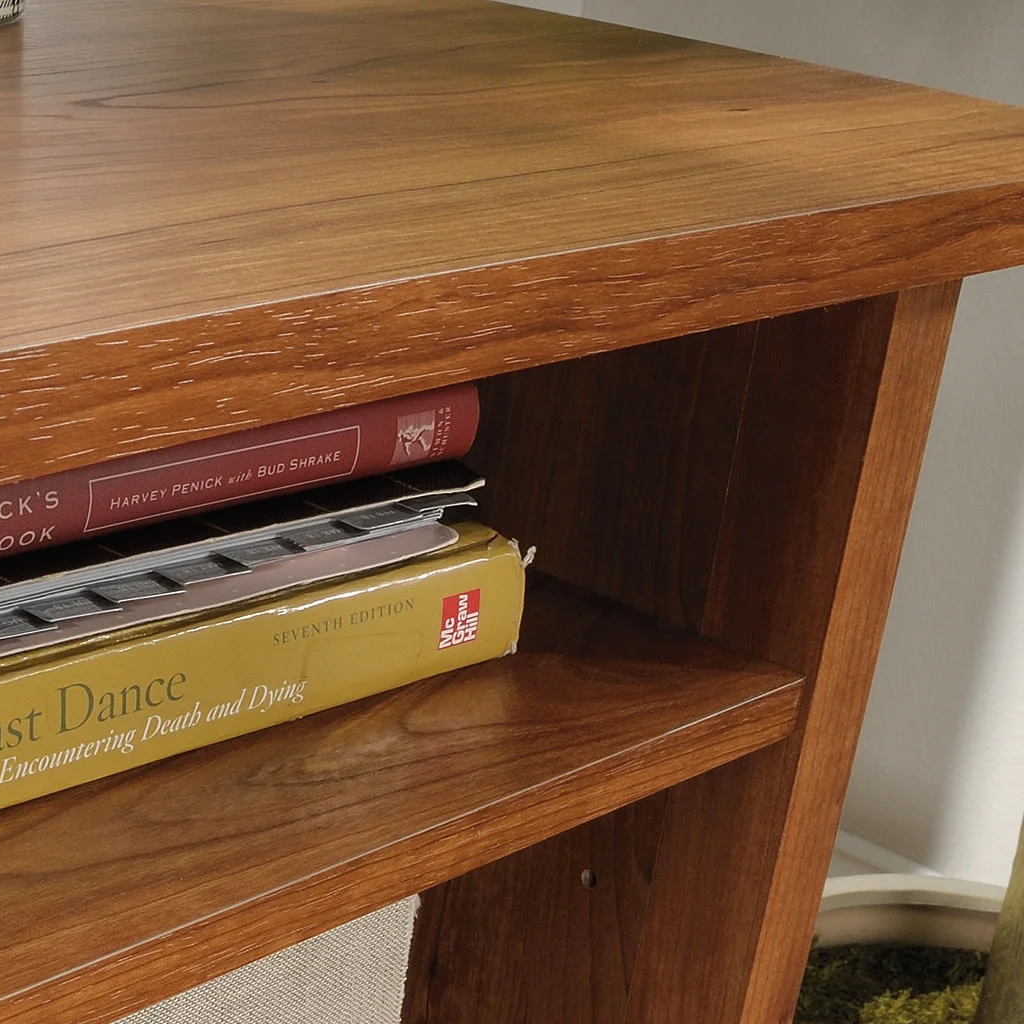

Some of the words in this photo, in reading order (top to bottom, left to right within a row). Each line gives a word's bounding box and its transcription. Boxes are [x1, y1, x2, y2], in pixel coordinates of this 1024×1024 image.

[110, 488, 167, 510] HARVEY
[171, 475, 223, 496] PENICK
[228, 469, 253, 485] with
[257, 462, 285, 479] BUD
[289, 450, 341, 471] SHRAKE
[272, 617, 343, 647] SEVENTH
[350, 598, 415, 626] EDITION
[438, 617, 455, 650] Mc
[451, 594, 469, 645] Graw
[463, 611, 480, 642] Hill
[56, 672, 187, 734] Dance
[141, 701, 201, 742] Death
[206, 688, 247, 722] and
[247, 679, 308, 714] Dying
